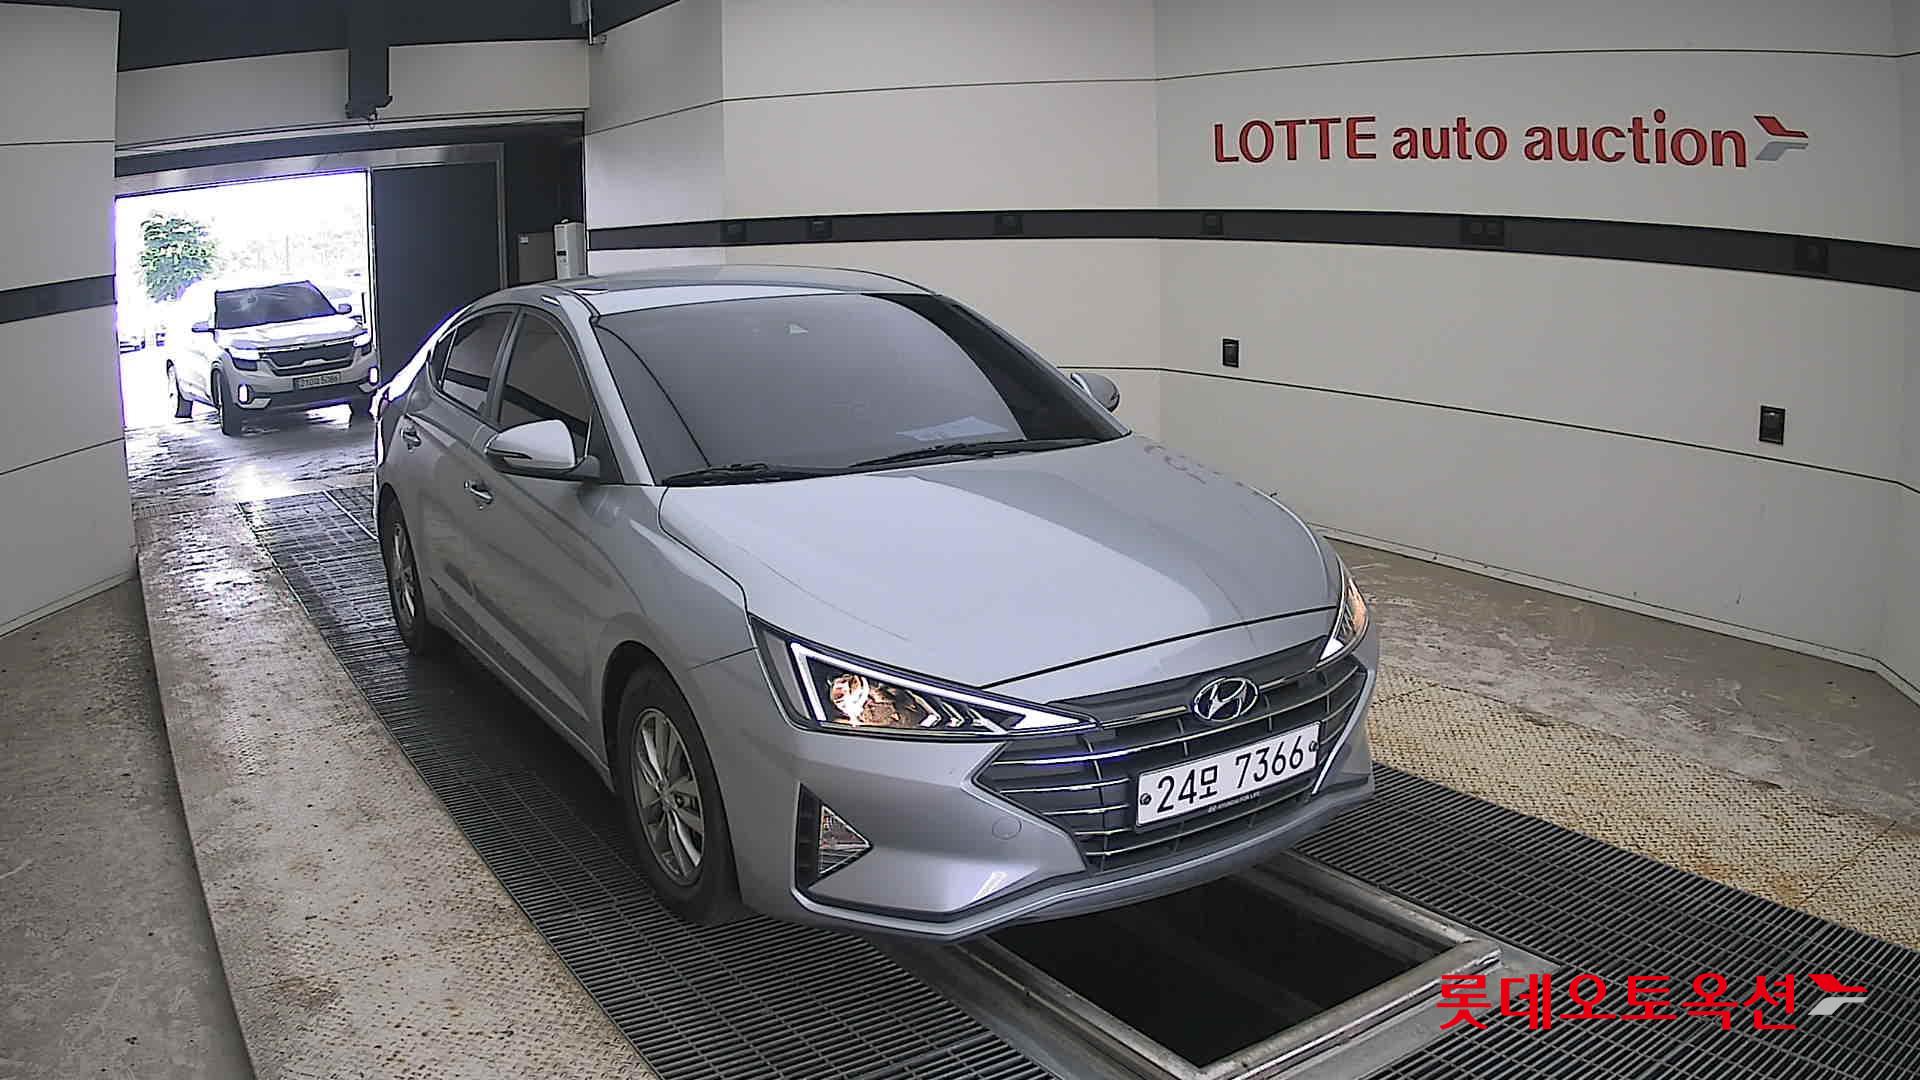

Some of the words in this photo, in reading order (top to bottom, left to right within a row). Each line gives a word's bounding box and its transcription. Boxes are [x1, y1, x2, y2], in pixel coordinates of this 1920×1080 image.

[1213, 115, 1377, 163] LOTTE
[1391, 116, 1509, 161] auto
[1522, 108, 1748, 168] auction
[1156, 764, 1218, 814] 24모
[1235, 735, 1304, 789] 7366
